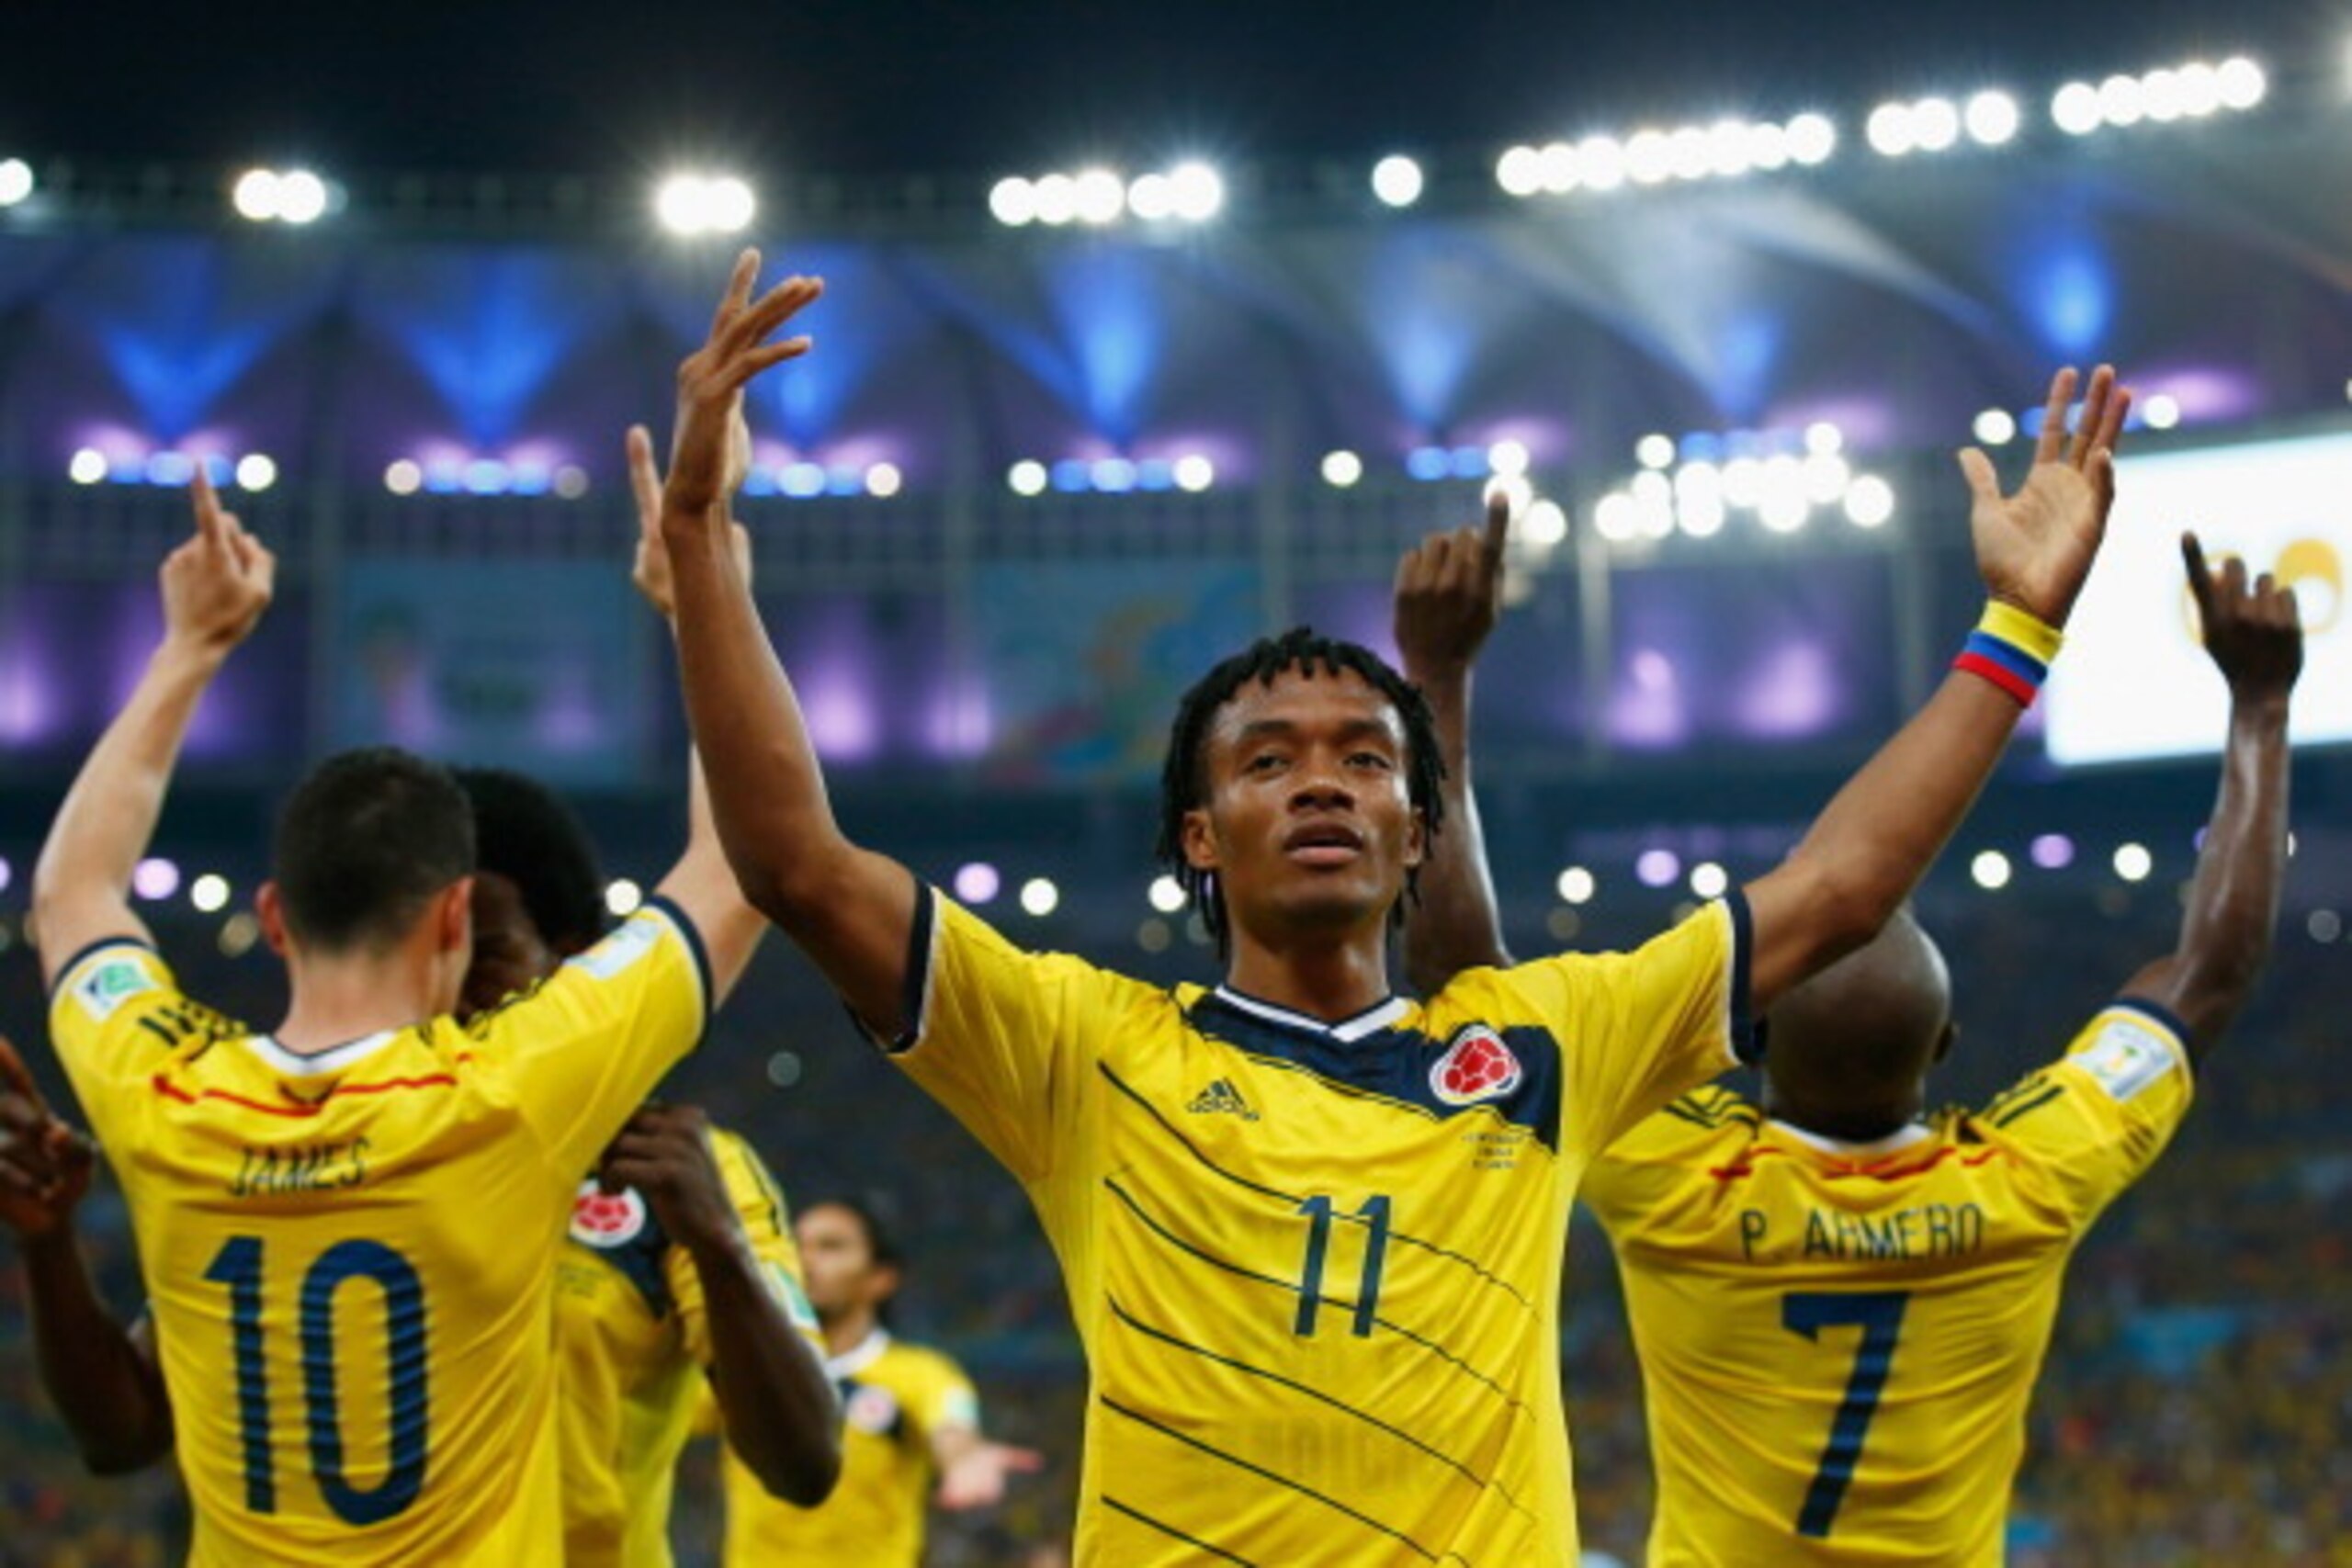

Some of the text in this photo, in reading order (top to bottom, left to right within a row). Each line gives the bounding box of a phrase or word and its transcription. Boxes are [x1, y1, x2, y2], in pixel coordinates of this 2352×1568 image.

[230, 1136, 370, 1198] JAMES
[1295, 1195, 1391, 1338] 11
[203, 1235, 428, 1528] 10
[1781, 1292, 1910, 1538] 7
